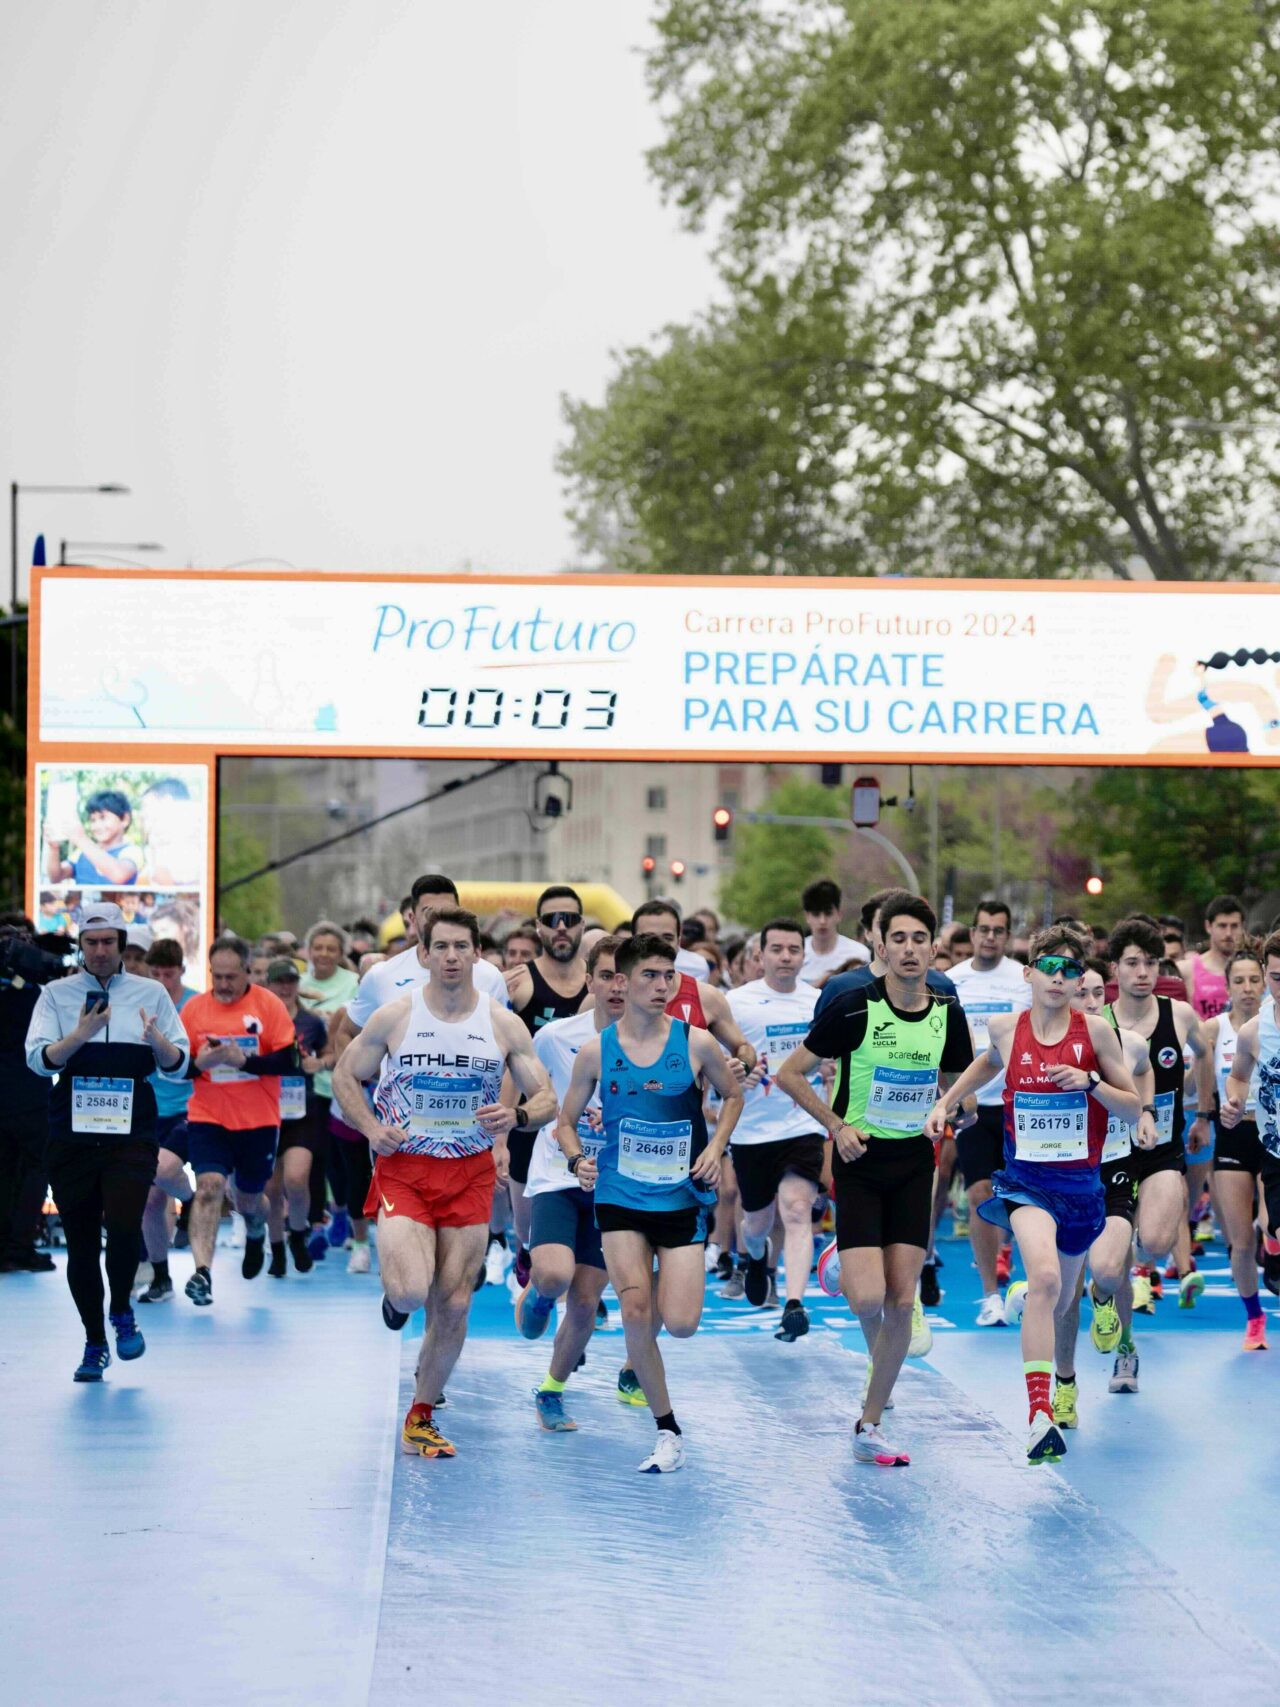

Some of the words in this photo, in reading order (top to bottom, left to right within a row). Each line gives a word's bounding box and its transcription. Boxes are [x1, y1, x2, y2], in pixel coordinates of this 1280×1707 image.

[373, 605, 636, 654] ProFuturo
[685, 609, 794, 635] Carrera
[805, 612, 952, 637] ProFuturo
[963, 614, 1037, 637] 2024
[684, 645, 945, 688] PREPÁRATE
[418, 687, 617, 730] 00:03
[684, 698, 800, 732] PARA
[814, 700, 871, 733] SU
[888, 700, 1100, 736] CARRERA
[894, 1050, 931, 1062] caredent
[87, 1097, 119, 1108] 25848
[888, 1090, 924, 1103] 26647
[428, 1098, 467, 1110] 26170
[1030, 1117, 1071, 1130] 26179
[636, 1142, 674, 1156] 26469
